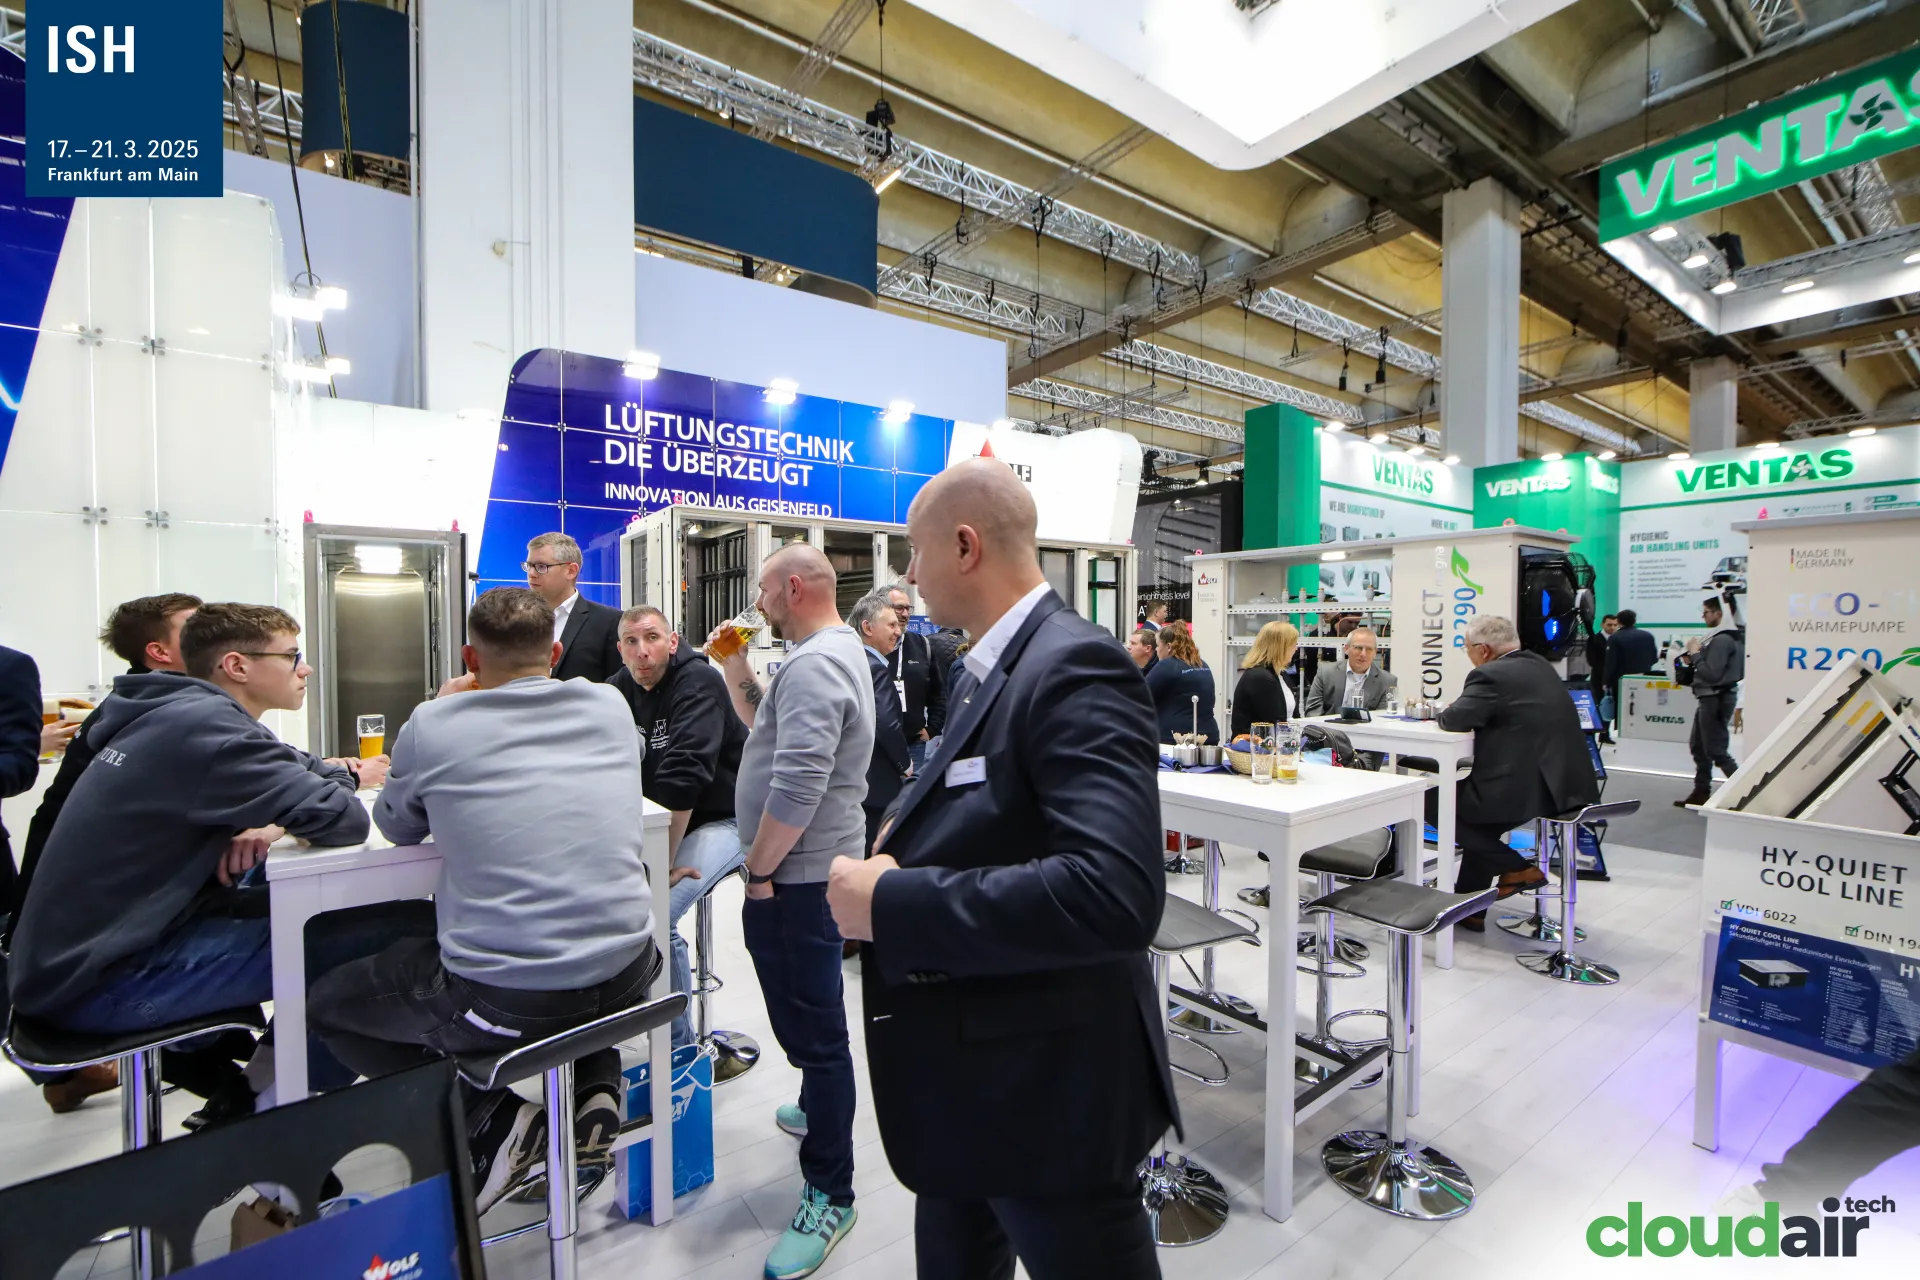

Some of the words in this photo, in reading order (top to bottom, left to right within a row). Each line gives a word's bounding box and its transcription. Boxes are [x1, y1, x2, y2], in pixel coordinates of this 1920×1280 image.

[1616, 66, 1920, 218] VENTA
[605, 402, 855, 462] LÜFTUNGSTECHNIK
[605, 439, 652, 469] DIE
[663, 442, 813, 487] ÜBERZEUGT
[1373, 454, 1434, 494] VENTAS
[1675, 449, 1854, 493] VENTAS
[1485, 473, 1571, 497] VENTAS
[605, 483, 710, 507] INNOVATION
[715, 494, 745, 510] AUS
[748, 498, 832, 518] GEISENFELD
[1630, 531, 1669, 542] HYGIENIC
[1630, 544, 1644, 553] AIR
[1647, 541, 1690, 553] HANDLING
[1693, 539, 1720, 550] UNITS
[1796, 549, 1829, 558] MADE
[1834, 548, 1846, 557] IN
[1796, 558, 1854, 569] GERMANY
[1174, 591, 1190, 599] level
[1789, 620, 1905, 633] WÄRMEPUMPE
[1422, 589, 1443, 700] CONNECT
[1645, 715, 1685, 724] VENTAS
[1762, 845, 1907, 885] HY-QUIET
[1760, 868, 1830, 896] COOL
[1841, 881, 1904, 909] LINE
[1736, 903, 1760, 917] VDI
[1764, 909, 1797, 925] 6022
[1729, 924, 1761, 936] HY-QUIET
[1763, 931, 1782, 941] COOL
[1784, 936, 1800, 945] LINE
[1864, 930, 1892, 944] DIN
[1899, 937, 1920, 951] 19
[1782, 942, 1791, 950] für
